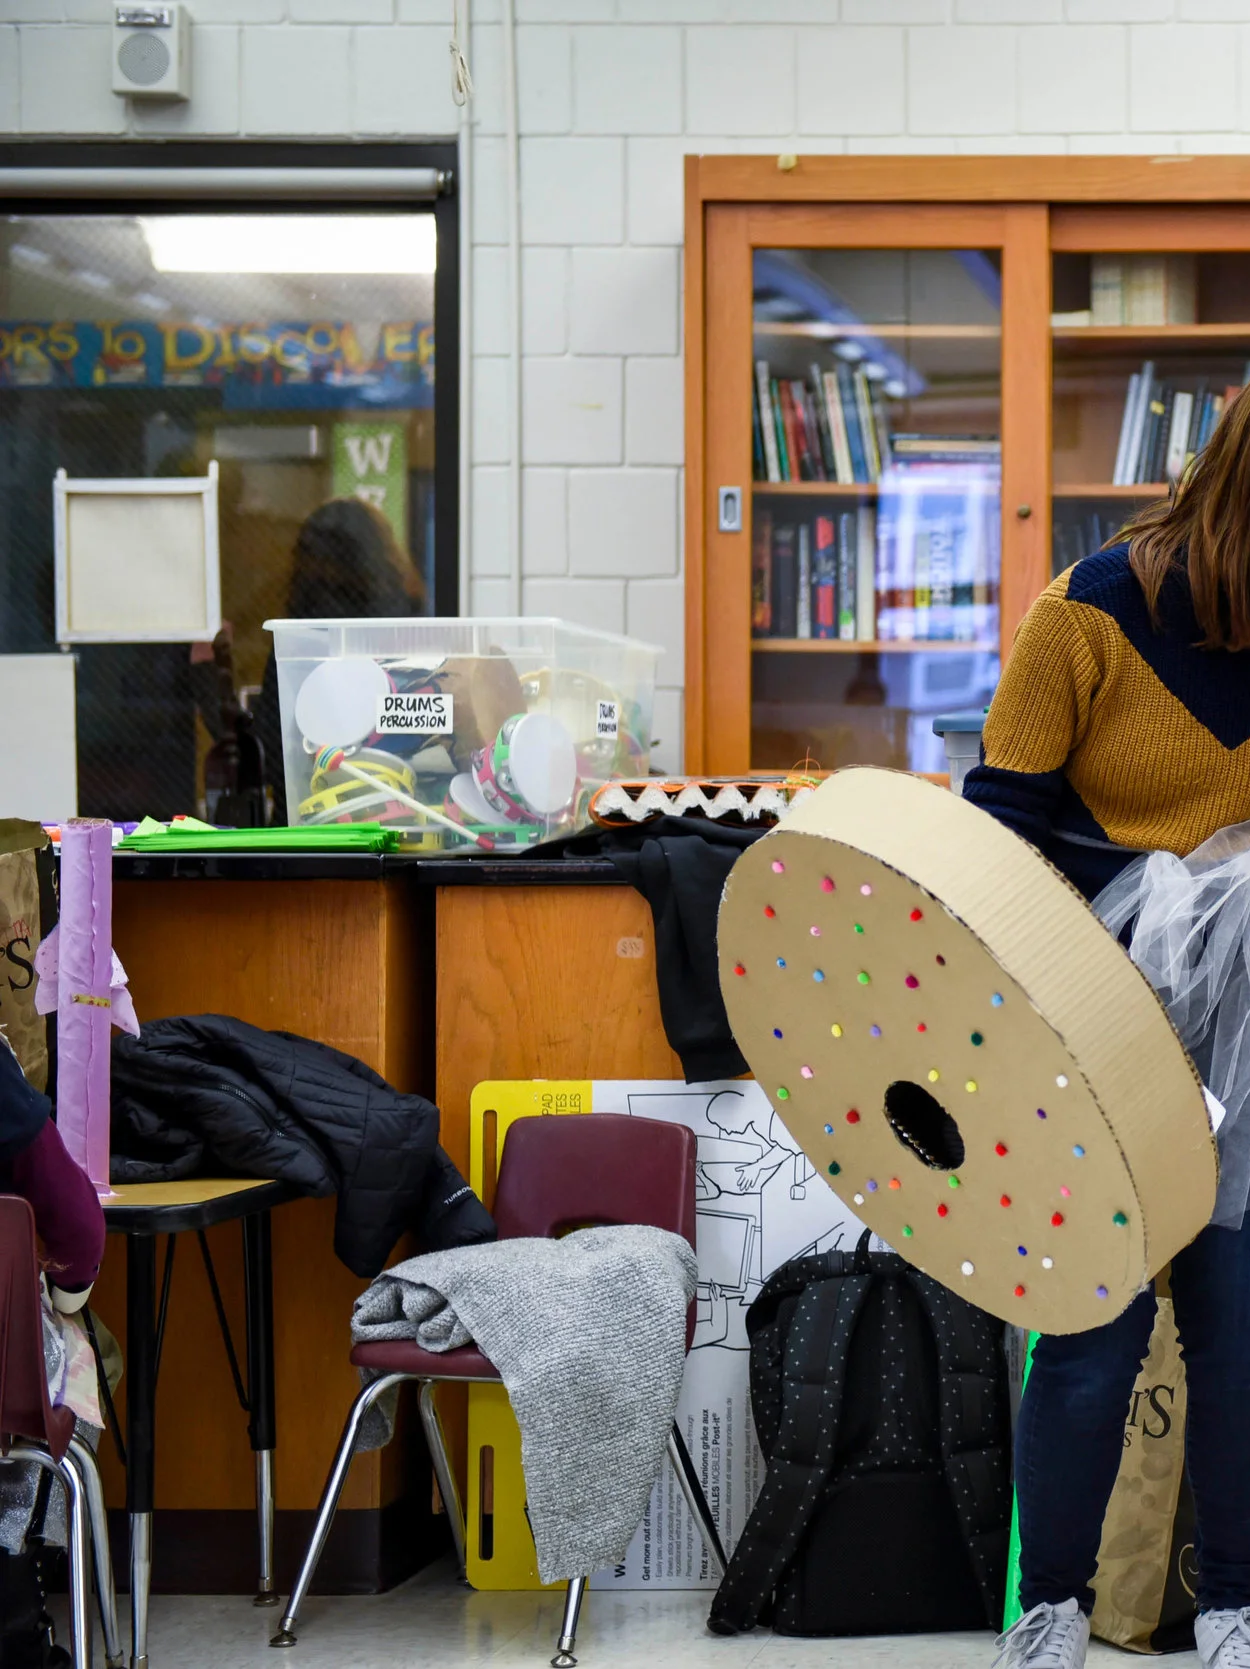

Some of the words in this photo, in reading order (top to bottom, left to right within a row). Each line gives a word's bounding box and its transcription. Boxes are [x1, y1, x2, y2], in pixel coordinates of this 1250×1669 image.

[384, 697, 445, 713] DRUMS
[380, 715, 446, 728] PERCUSSION
[700, 1426, 710, 1450] grâce
[700, 1452, 709, 1488] réunions
[712, 1447, 721, 1484] MOBILES
[642, 1518, 651, 1527] of
[643, 1528, 651, 1542] out
[643, 1543, 651, 1564] more
[642, 1566, 651, 1581] Get
[699, 1559, 708, 1581] Tirez
